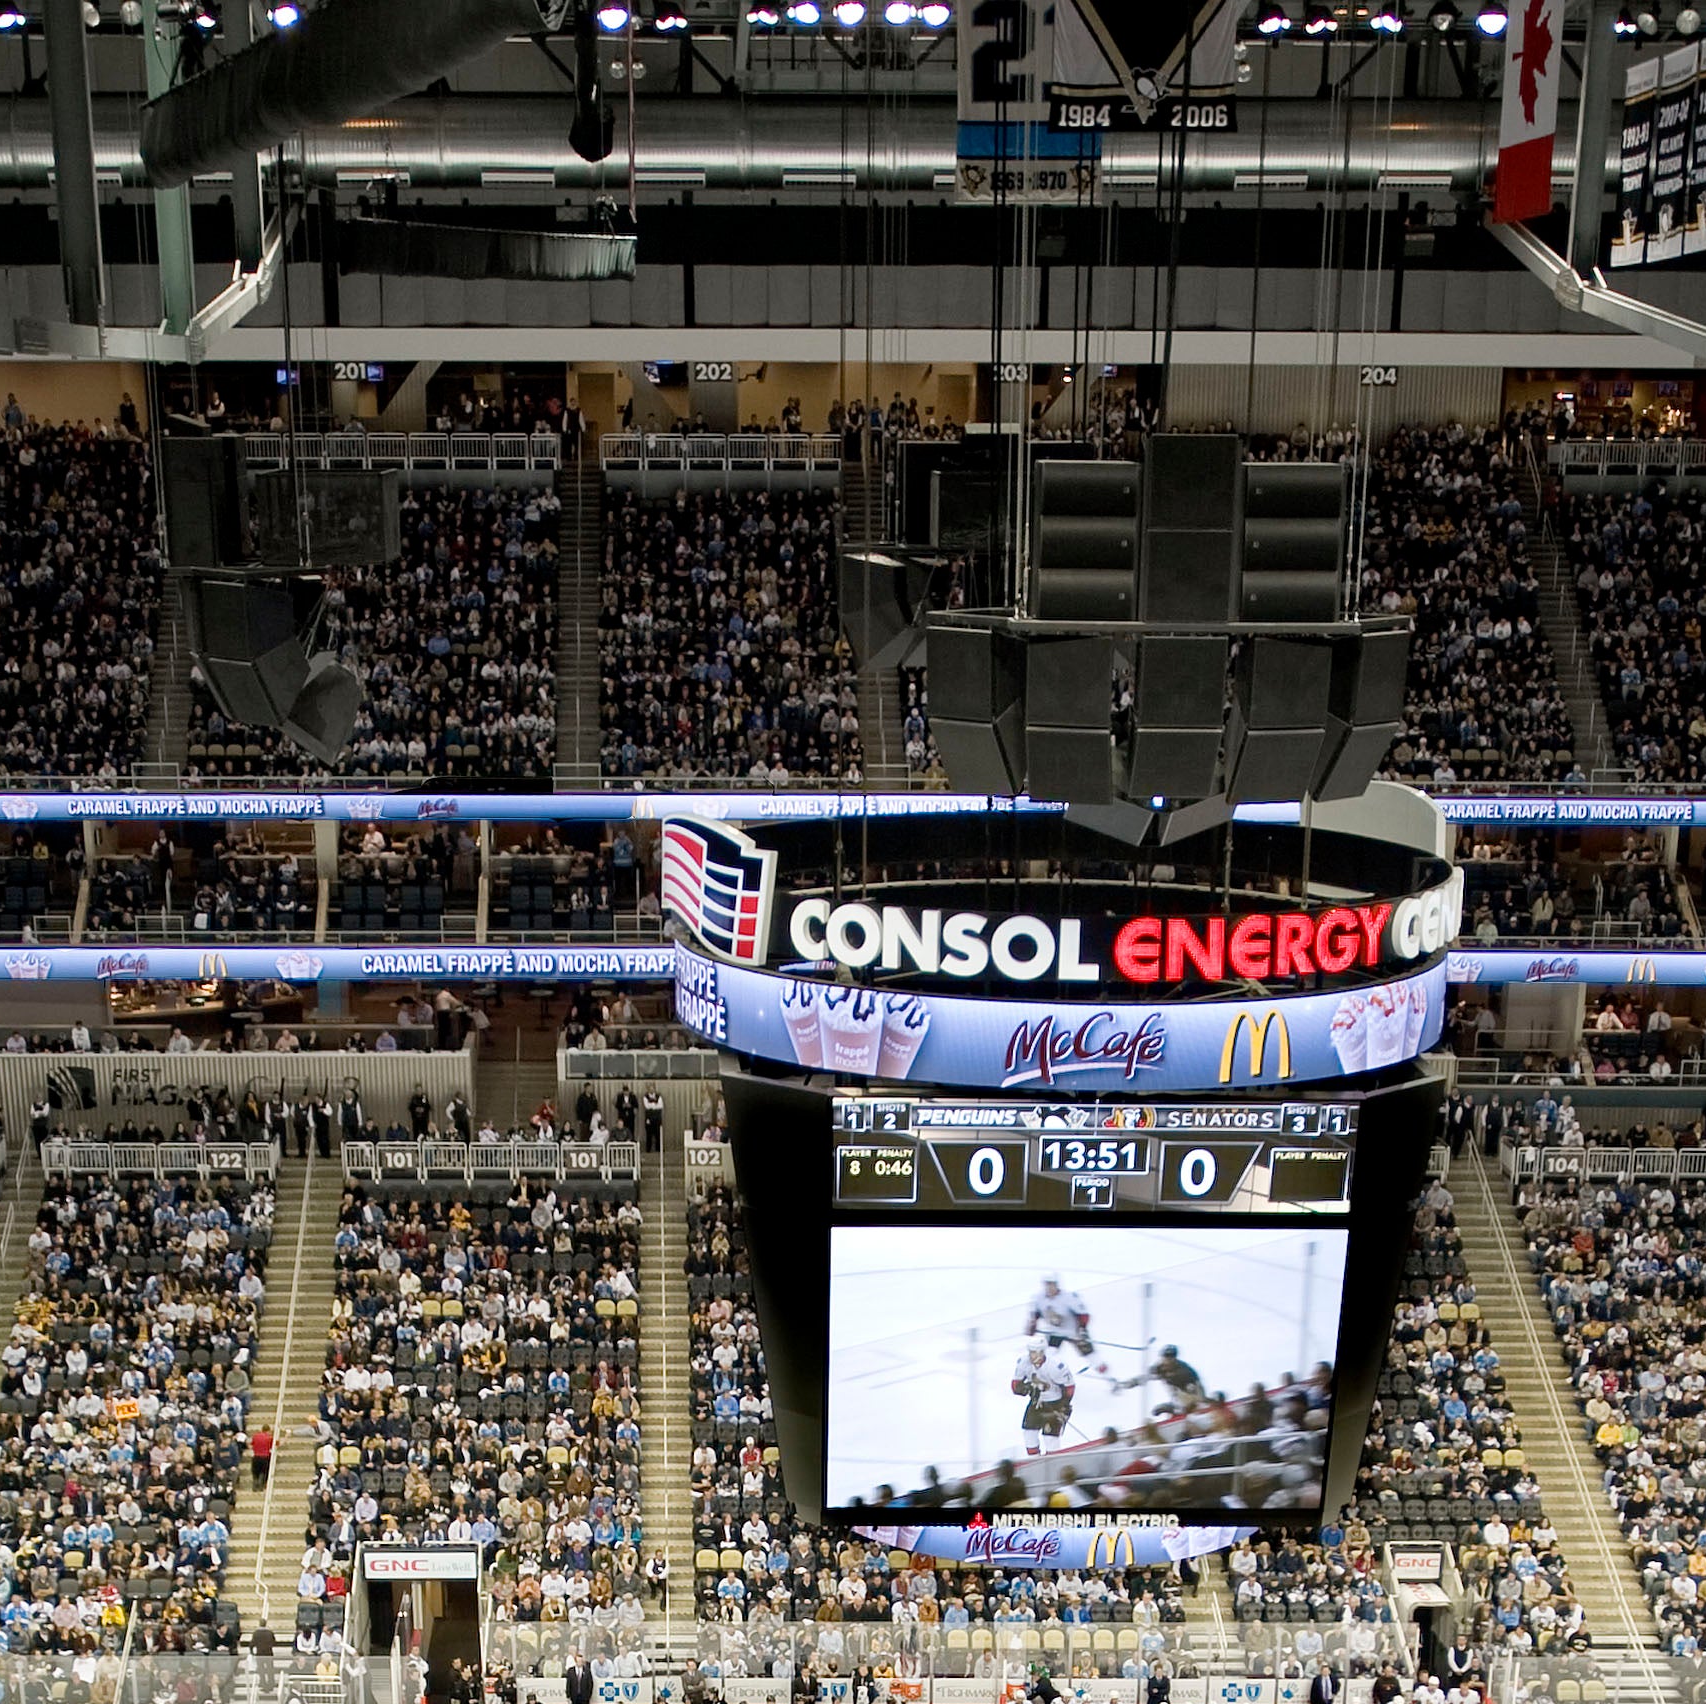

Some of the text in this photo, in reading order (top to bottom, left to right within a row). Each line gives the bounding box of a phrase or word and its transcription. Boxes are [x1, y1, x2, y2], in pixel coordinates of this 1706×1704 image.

[1058, 104, 1228, 127] 1984 2006
[334, 362, 367, 381] 201
[694, 362, 732, 381] 202
[1360, 366, 1397, 386] 204
[67, 796, 323, 815] CARAMEL FRAPPÉ AND MOCHA FRAPPÉ
[1440, 800, 1693, 820] CARAMEL FRAPPÉ AND MOCHA FRAPPÉ
[790, 896, 1393, 982] CONSOL ENERGY
[361, 949, 620, 974] CARAMEL FRAPPÉ AND MOCHA
[1004, 1010, 1169, 1085] McCafé
[847, 1113, 858, 1130] 1
[883, 1112, 897, 1130] 2
[915, 1107, 1018, 1127] PENGUINS
[1166, 1110, 1275, 1128] SENATORS
[1292, 1116, 1306, 1133] 3
[1331, 1115, 1343, 1132] 1
[210, 1151, 244, 1169] 122
[385, 1152, 413, 1168] 101
[569, 1152, 598, 1168] 101
[689, 1149, 721, 1166] 102
[1044, 1141, 1138, 1171] 13:51
[1547, 1157, 1578, 1173] 104
[849, 1159, 913, 1176] 8 0:46
[968, 1148, 1006, 1197] 0
[1179, 1148, 1218, 1198] 0
[1075, 1177, 1110, 1188] PERIOD
[1086, 1188, 1099, 1205] 1
[992, 1513, 1180, 1529] MITSUBISHI ELECTRIC
[369, 1559, 430, 1573] GNC
[1396, 1557, 1440, 1569] GNC
